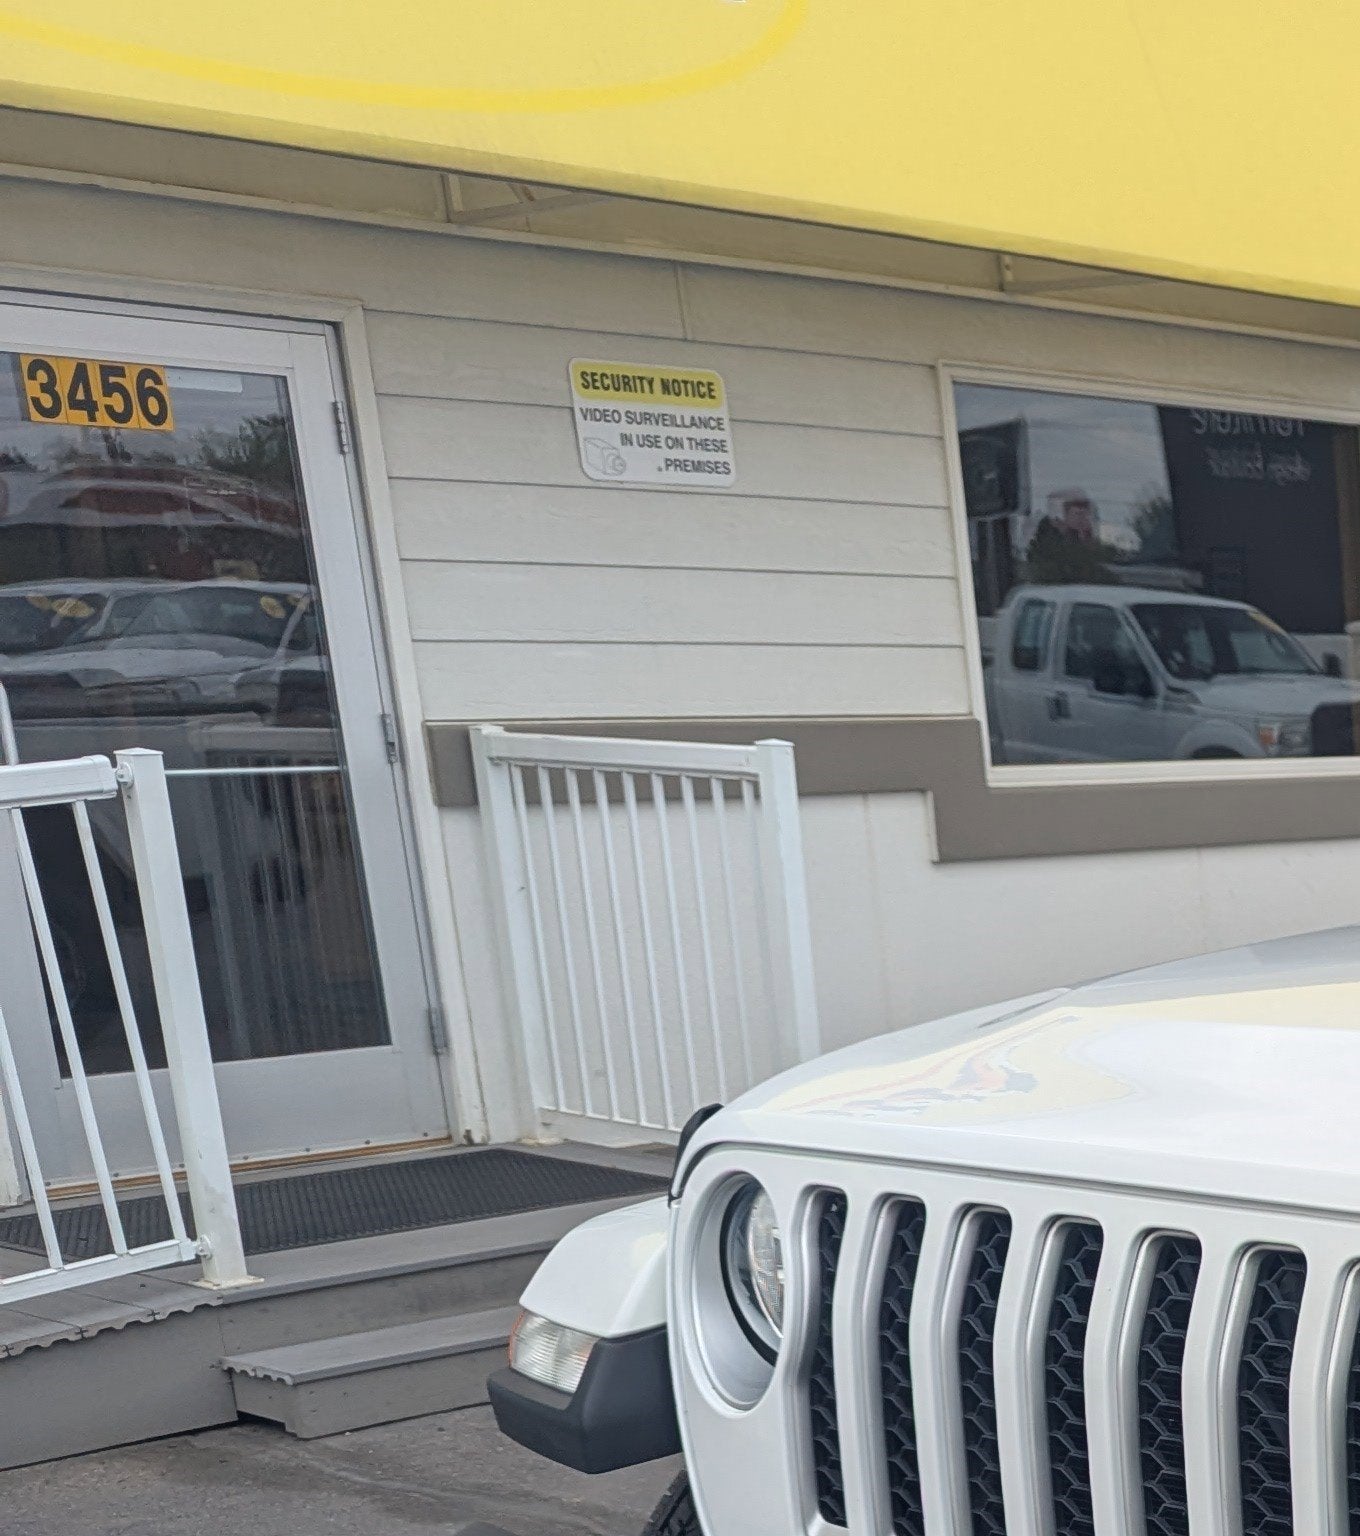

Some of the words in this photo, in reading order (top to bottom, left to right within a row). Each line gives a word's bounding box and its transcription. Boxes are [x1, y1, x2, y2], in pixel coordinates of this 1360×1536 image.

[27, 358, 169, 426] 3456
[580, 370, 655, 395] SECURITY
[660, 377, 717, 400] NOTICE
[579, 406, 622, 424] VIDEO
[625, 410, 726, 431] SURVEILLANCE
[620, 432, 634, 447] IN
[636, 434, 663, 450] USE
[665, 435, 684, 451] ON
[685, 437, 728, 453] THESE
[664, 457, 732, 476] PREMISES
